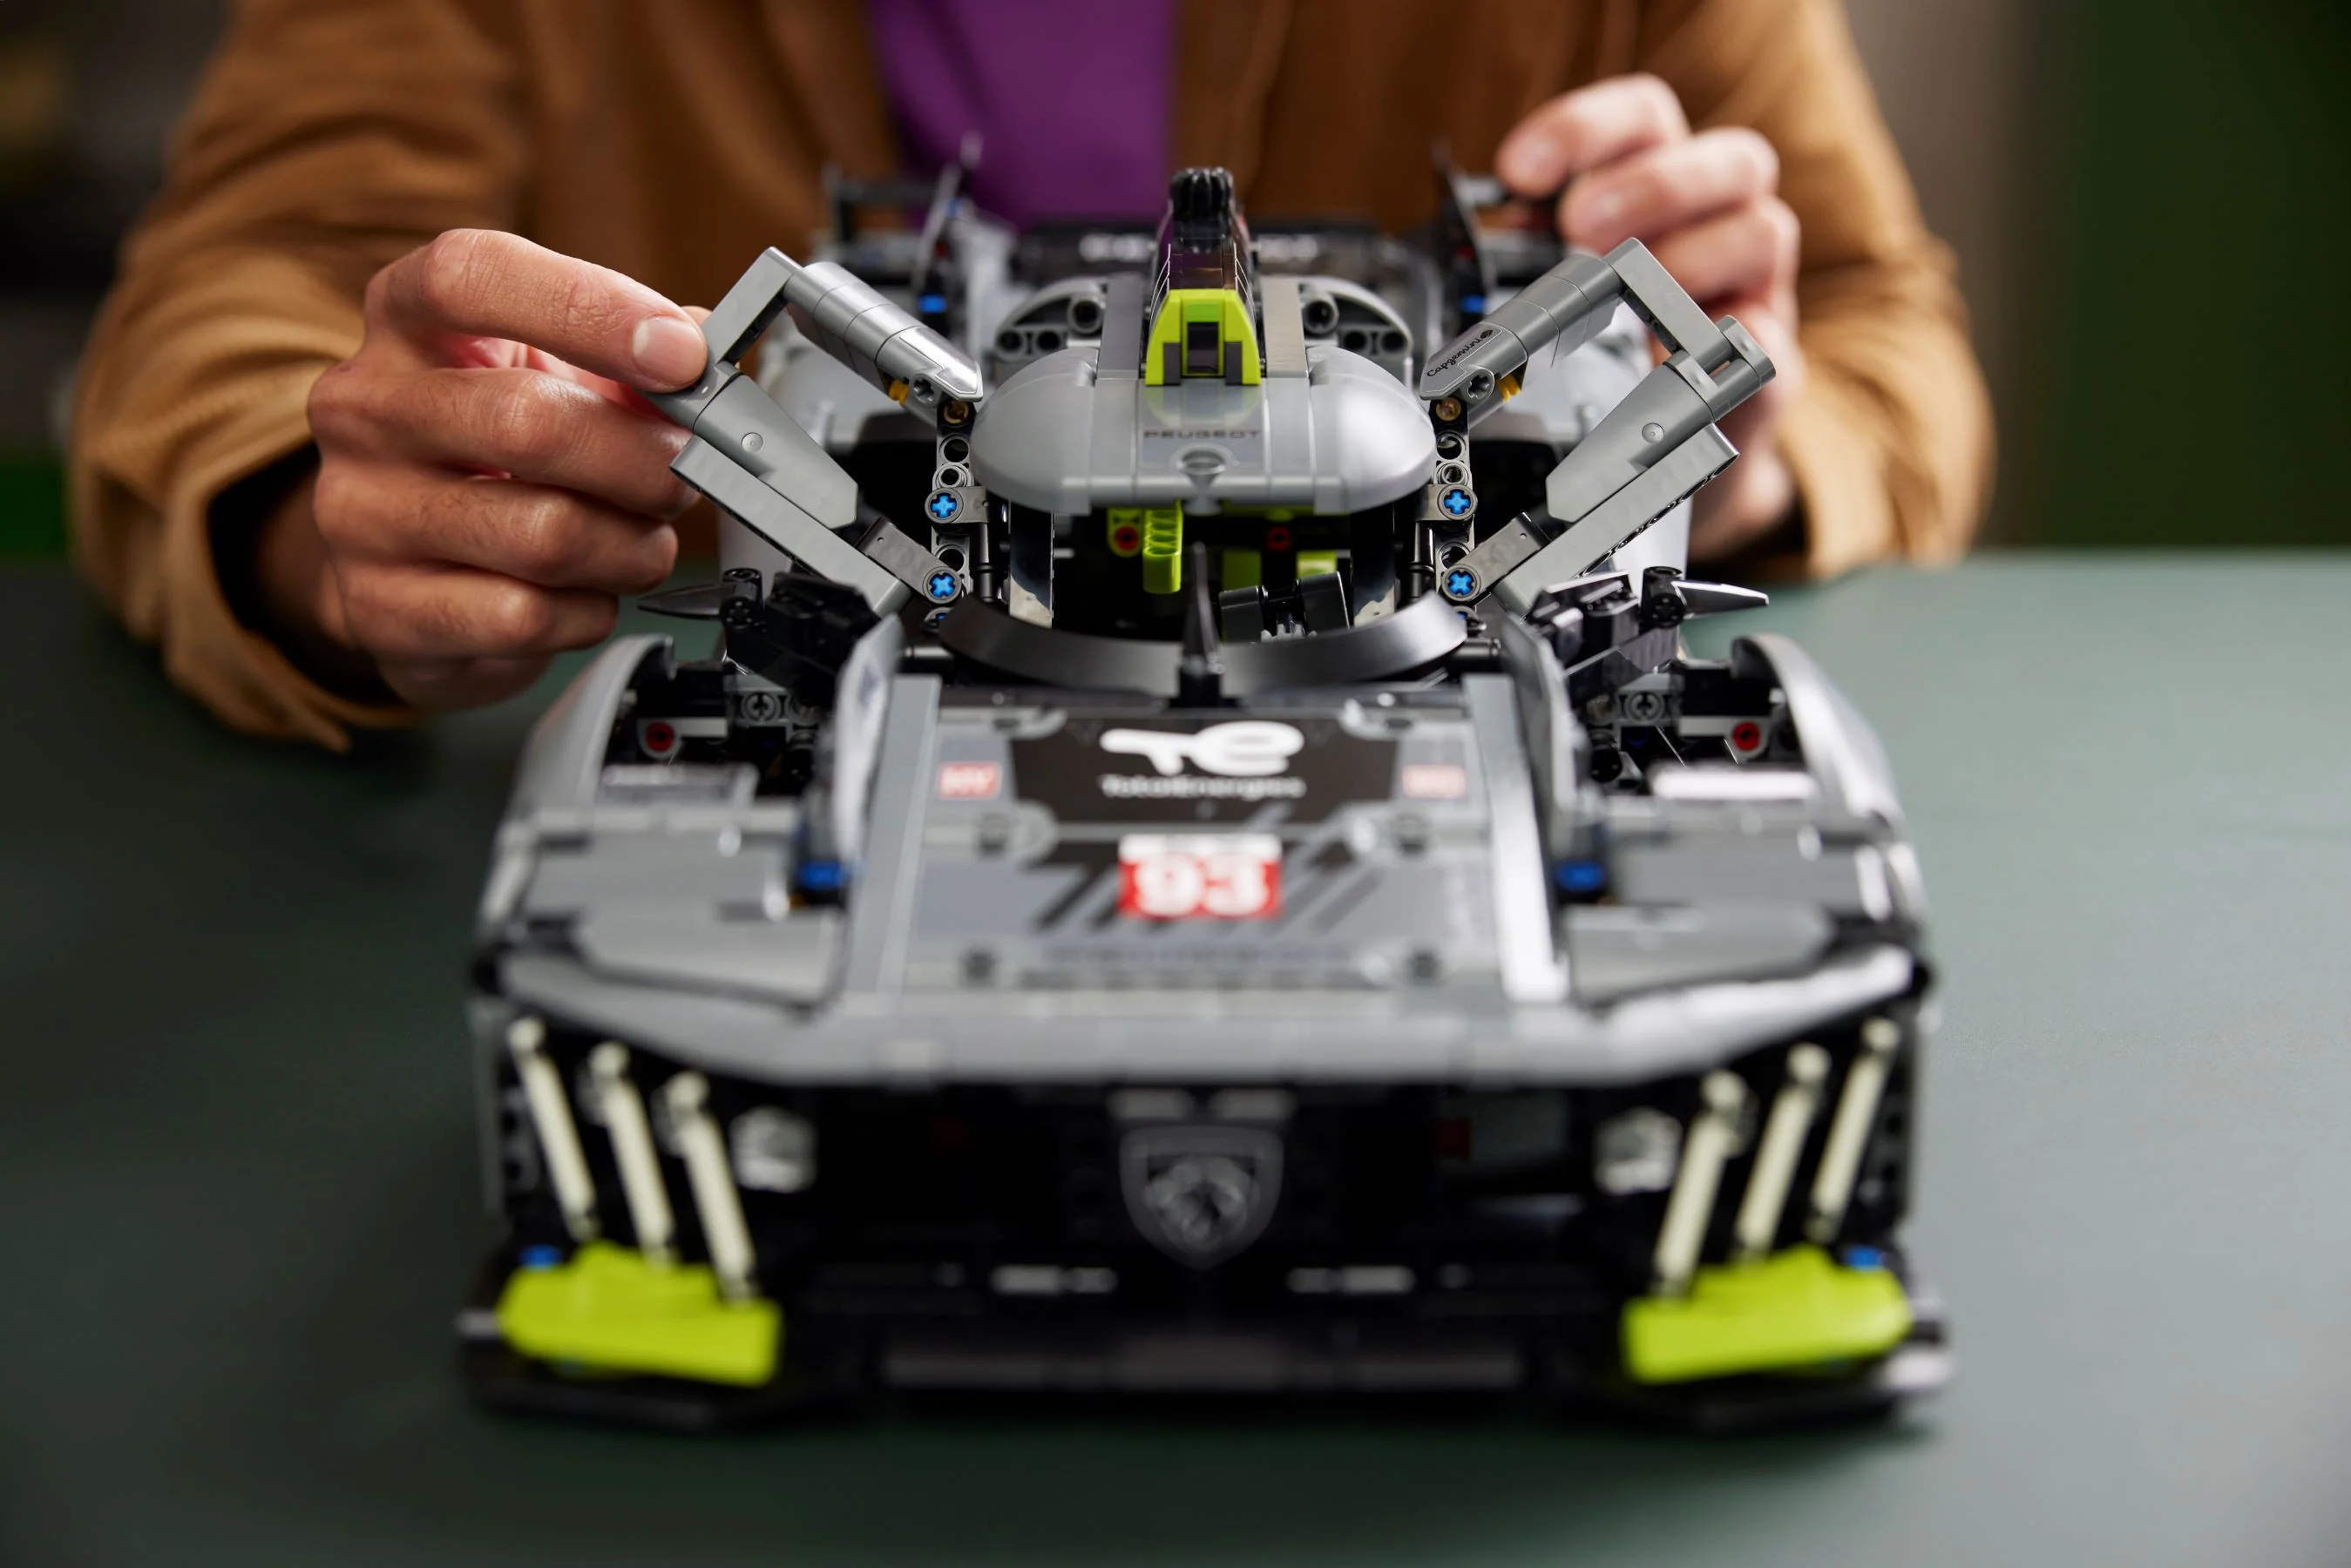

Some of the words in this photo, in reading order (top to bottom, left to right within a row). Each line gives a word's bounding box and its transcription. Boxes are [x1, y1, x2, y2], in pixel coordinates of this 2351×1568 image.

[1426, 336, 1483, 377] Capgemini
[1143, 429, 1260, 439] PEUGEOT
[1135, 852, 1270, 916] 93
